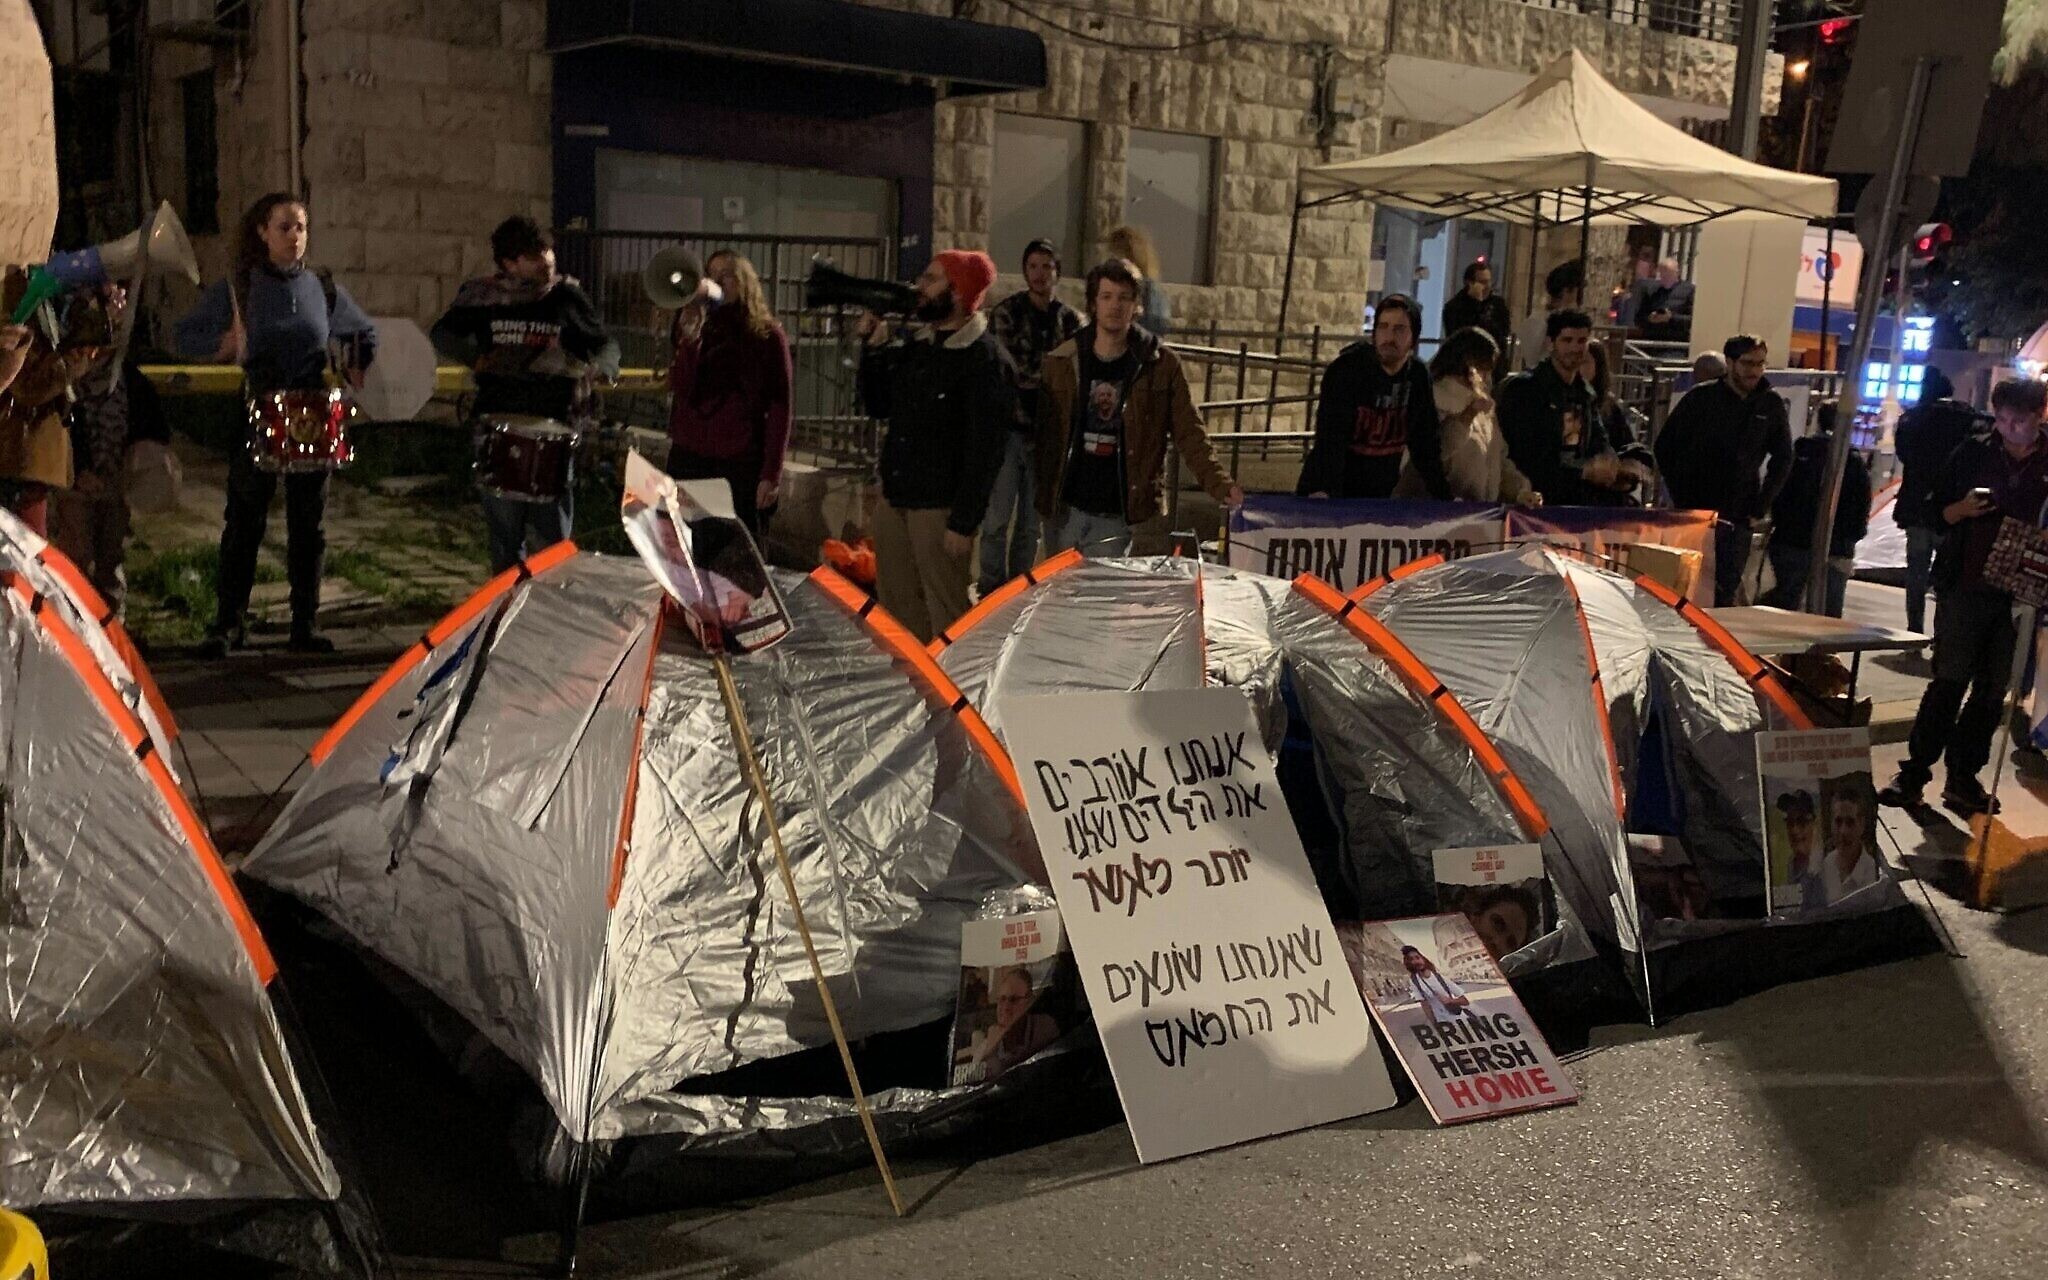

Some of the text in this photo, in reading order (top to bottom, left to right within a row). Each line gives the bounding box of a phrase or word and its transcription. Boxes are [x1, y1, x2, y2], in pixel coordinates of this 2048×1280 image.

[1034, 732, 1255, 812] אנחנו אוהבים
[1065, 782, 1267, 860] את הילדים שלנו
[1072, 845, 1251, 917] יותר מאשר
[1102, 924, 1322, 1007] שאנחנו שונאים
[1145, 979, 1335, 1067] את החמאס
[1410, 1013, 1521, 1050] BRING
[1427, 1040, 1540, 1079] HERSH
[1444, 1067, 1557, 1108] HOME
